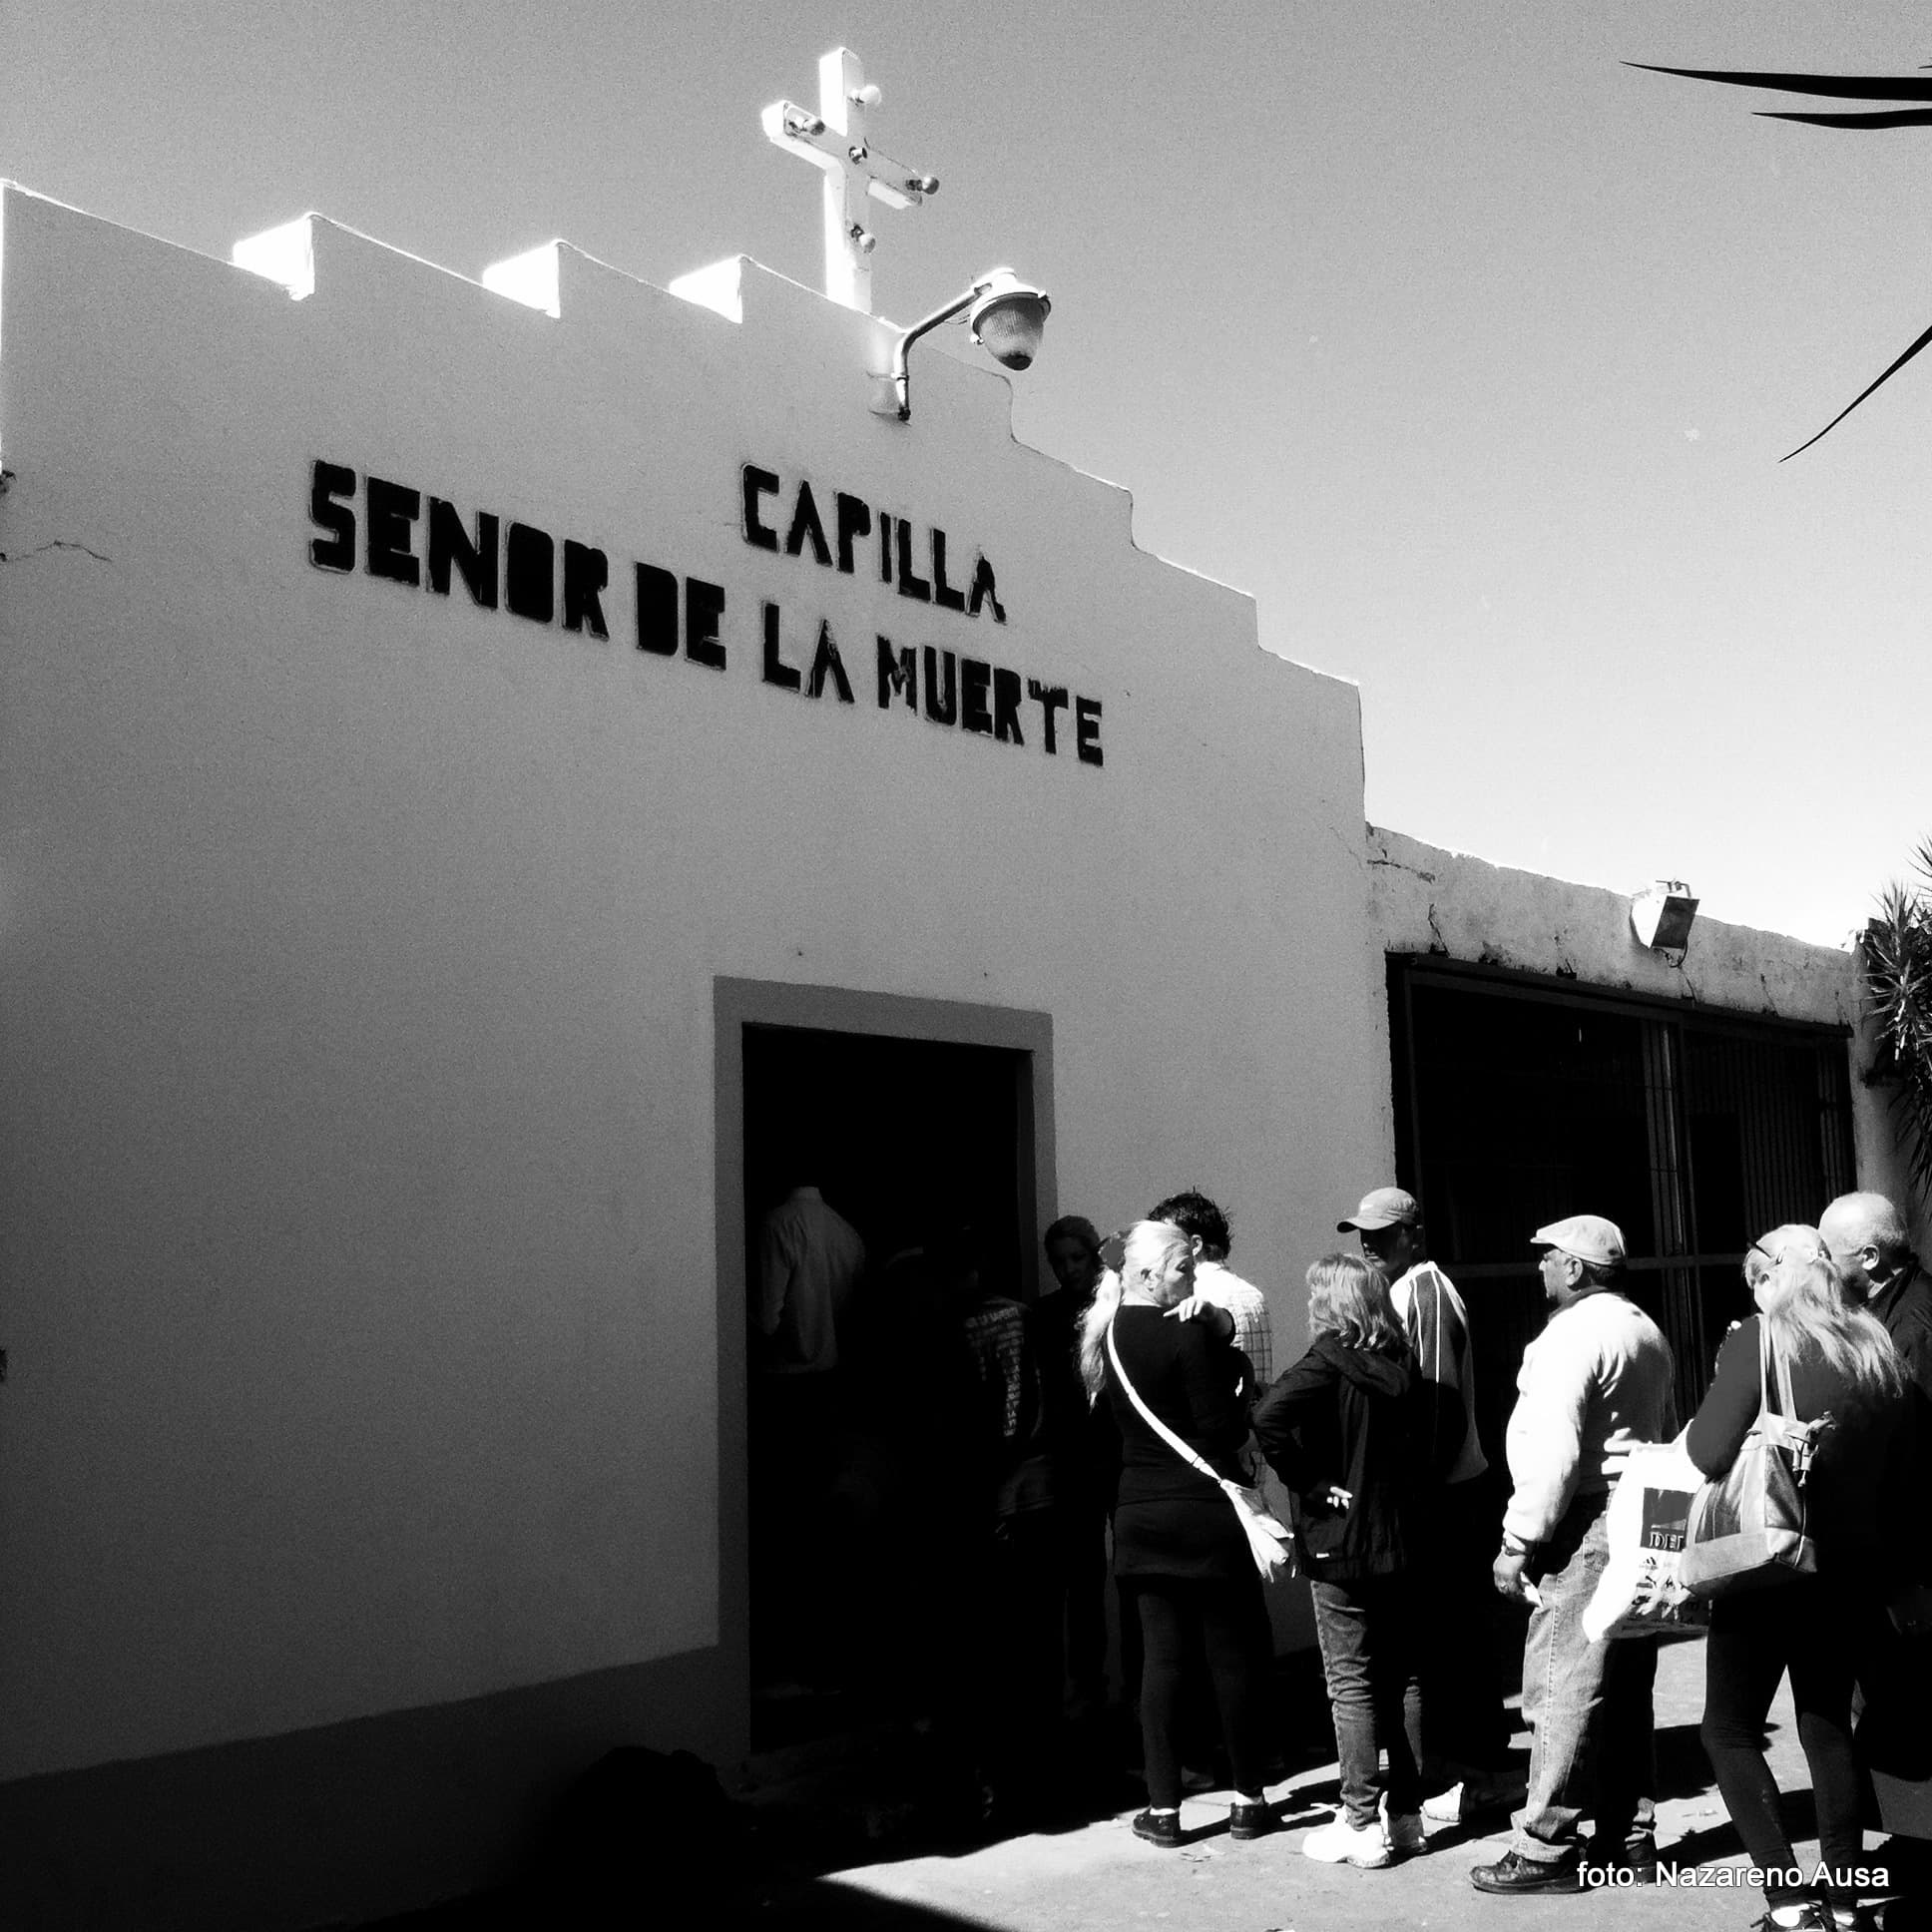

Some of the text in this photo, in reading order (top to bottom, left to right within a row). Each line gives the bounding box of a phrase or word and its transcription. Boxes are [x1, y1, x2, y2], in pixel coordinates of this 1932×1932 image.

[741, 463, 1008, 624] CAPILLA
[634, 562, 726, 670] DE
[762, 603, 855, 705] LA
[877, 636, 1104, 765] MUERTE
